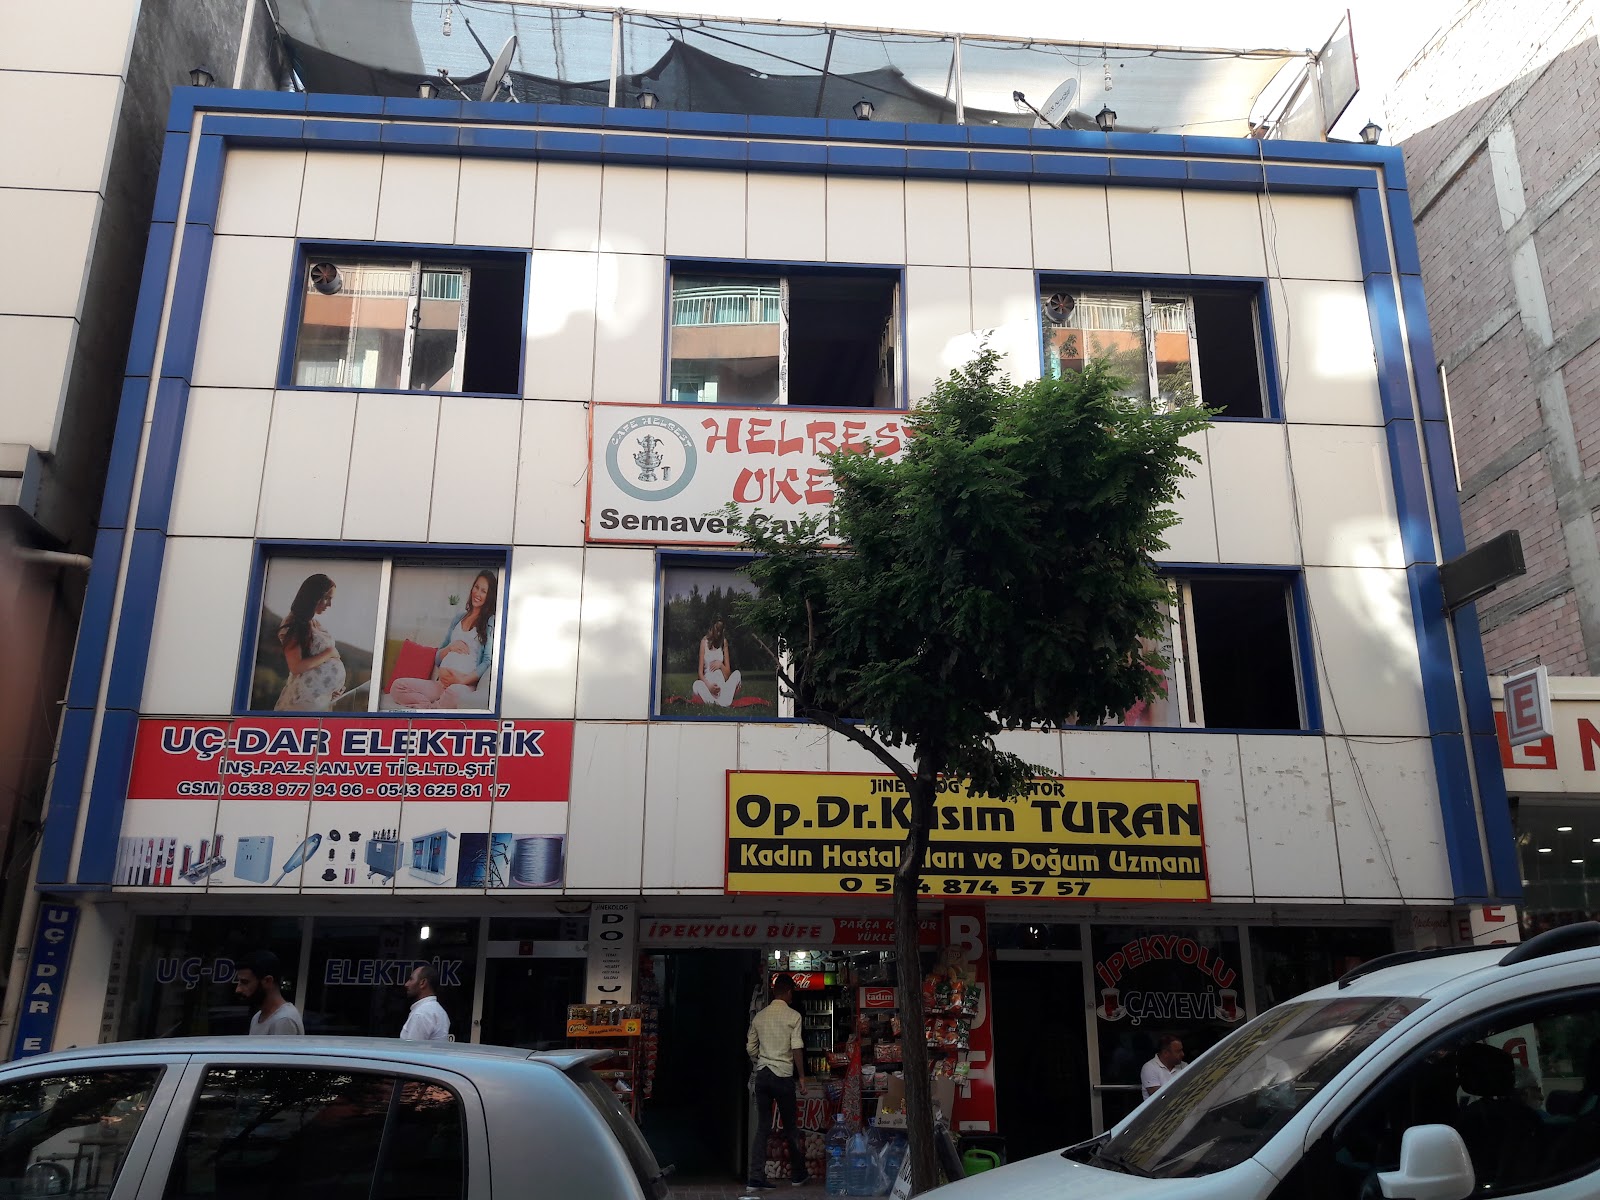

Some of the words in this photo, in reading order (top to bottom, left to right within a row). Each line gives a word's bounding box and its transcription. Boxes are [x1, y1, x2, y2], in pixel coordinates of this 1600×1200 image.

[611, 420, 638, 445] CAFE
[733, 467, 836, 505] OKE
[1513, 684, 1537, 729] E
[161, 726, 331, 760] UÇ-DAR
[342, 721, 545, 757] ELEKTRİK
[229, 782, 273, 796] 0538
[276, 783, 310, 796] 977
[314, 783, 337, 797] 94
[340, 784, 363, 797] 96
[377, 784, 421, 797] 0543
[424, 784, 458, 797] 625
[461, 784, 483, 797] 81
[1031, 800, 1200, 838] TURAN
[741, 843, 812, 867] Kadın
[823, 845, 965, 869] Hastalları
[974, 850, 1003, 870] ve
[1012, 847, 1099, 876] Doğum
[1109, 850, 1200, 873] Uzmanı
[875, 878, 931, 893] 54
[943, 880, 999, 894] 874
[1011, 881, 1045, 895] 57
[1057, 882, 1091, 896] 57
[648, 922, 756, 938] İPEKYOLU
[767, 923, 822, 938] BÜFE
[840, 919, 880, 930] PARÇA
[156, 957, 241, 989] UÇ-D
[1096, 934, 1236, 989] İPEKYOLU
[866, 993, 894, 1002] tadım
[1124, 985, 1217, 1026] ÇAYEVİ
